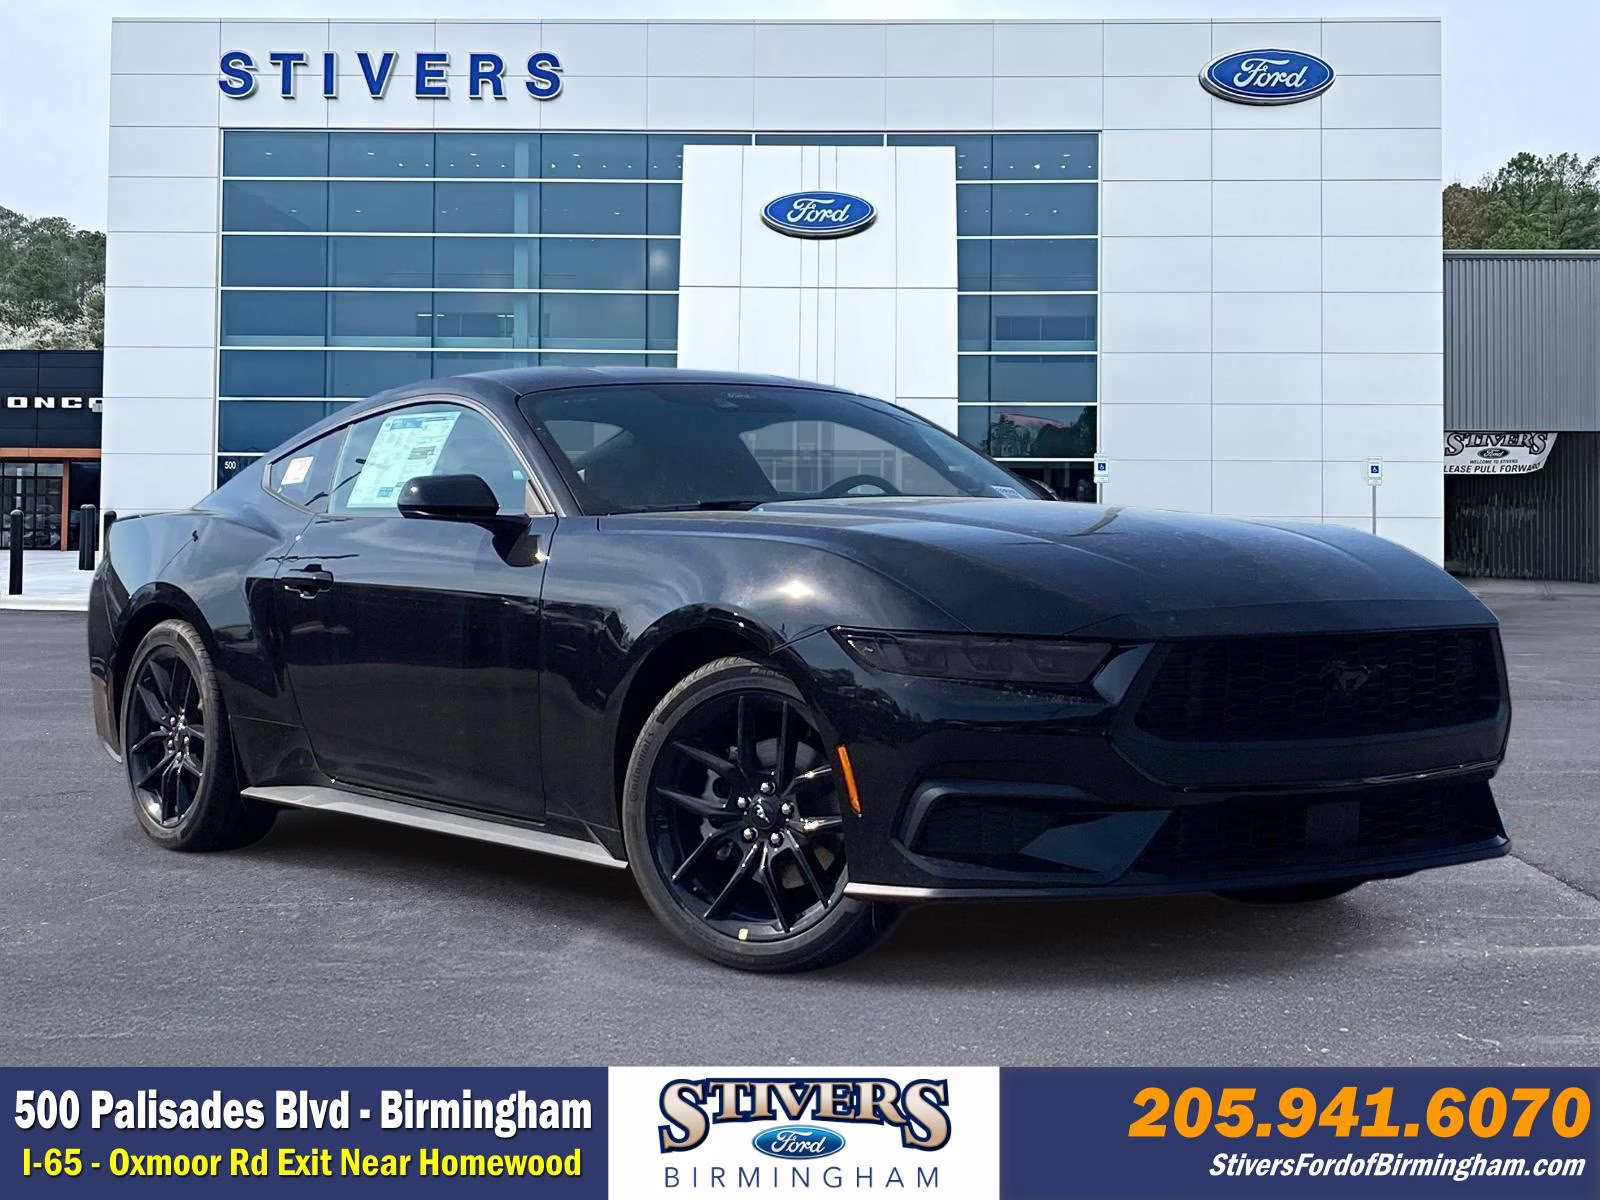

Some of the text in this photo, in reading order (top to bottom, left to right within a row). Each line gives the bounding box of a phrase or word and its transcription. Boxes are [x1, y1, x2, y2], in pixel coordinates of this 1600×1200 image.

[219, 50, 565, 101] STIVERS
[1233, 57, 1309, 88] Ford
[786, 197, 852, 223] Ford
[1444, 431, 1548, 456] STIVERS
[224, 460, 238, 470] 500
[1474, 465, 1497, 473] PULL
